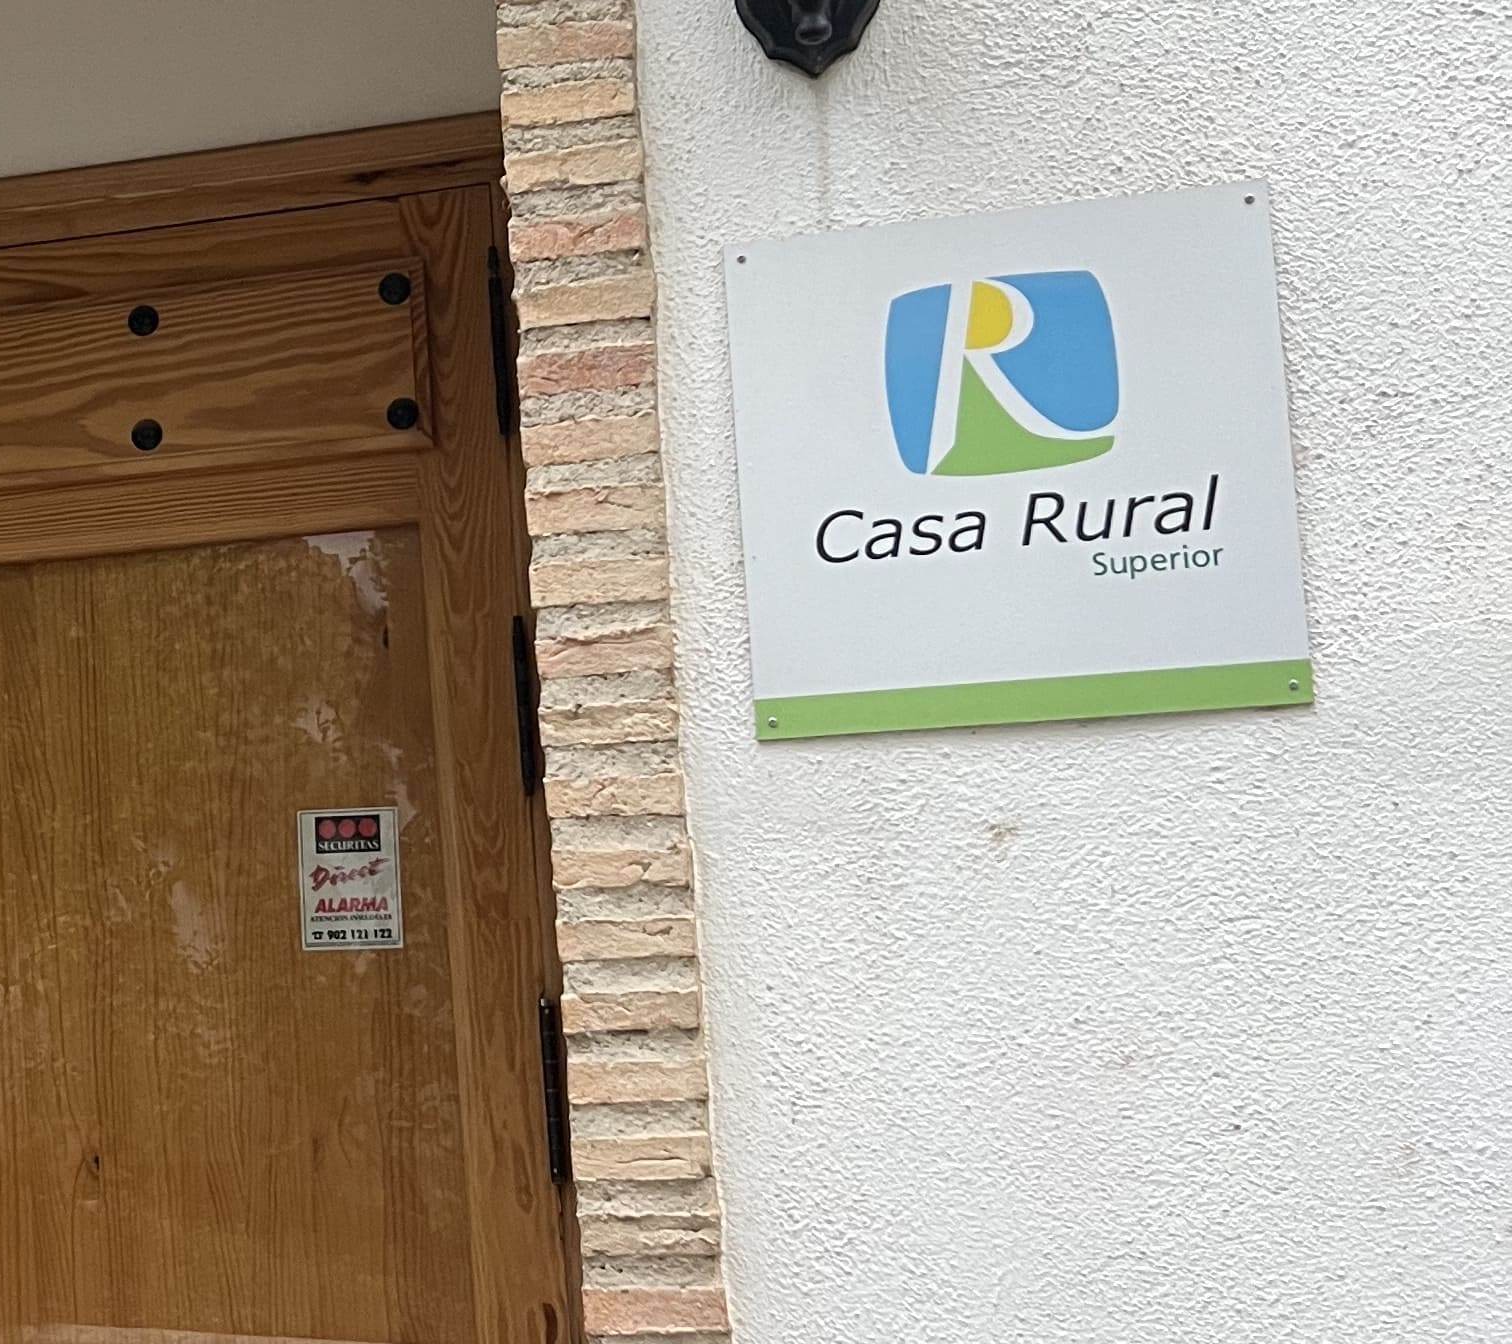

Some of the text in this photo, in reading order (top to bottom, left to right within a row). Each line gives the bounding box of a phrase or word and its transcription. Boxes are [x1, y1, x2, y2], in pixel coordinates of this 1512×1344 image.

[815, 474, 1220, 564] Casa Rural
[1091, 544, 1224, 579] Superior
[318, 840, 379, 851] SECURITAS
[314, 897, 388, 914] ALARMA
[327, 928, 393, 940] 902 121 122
